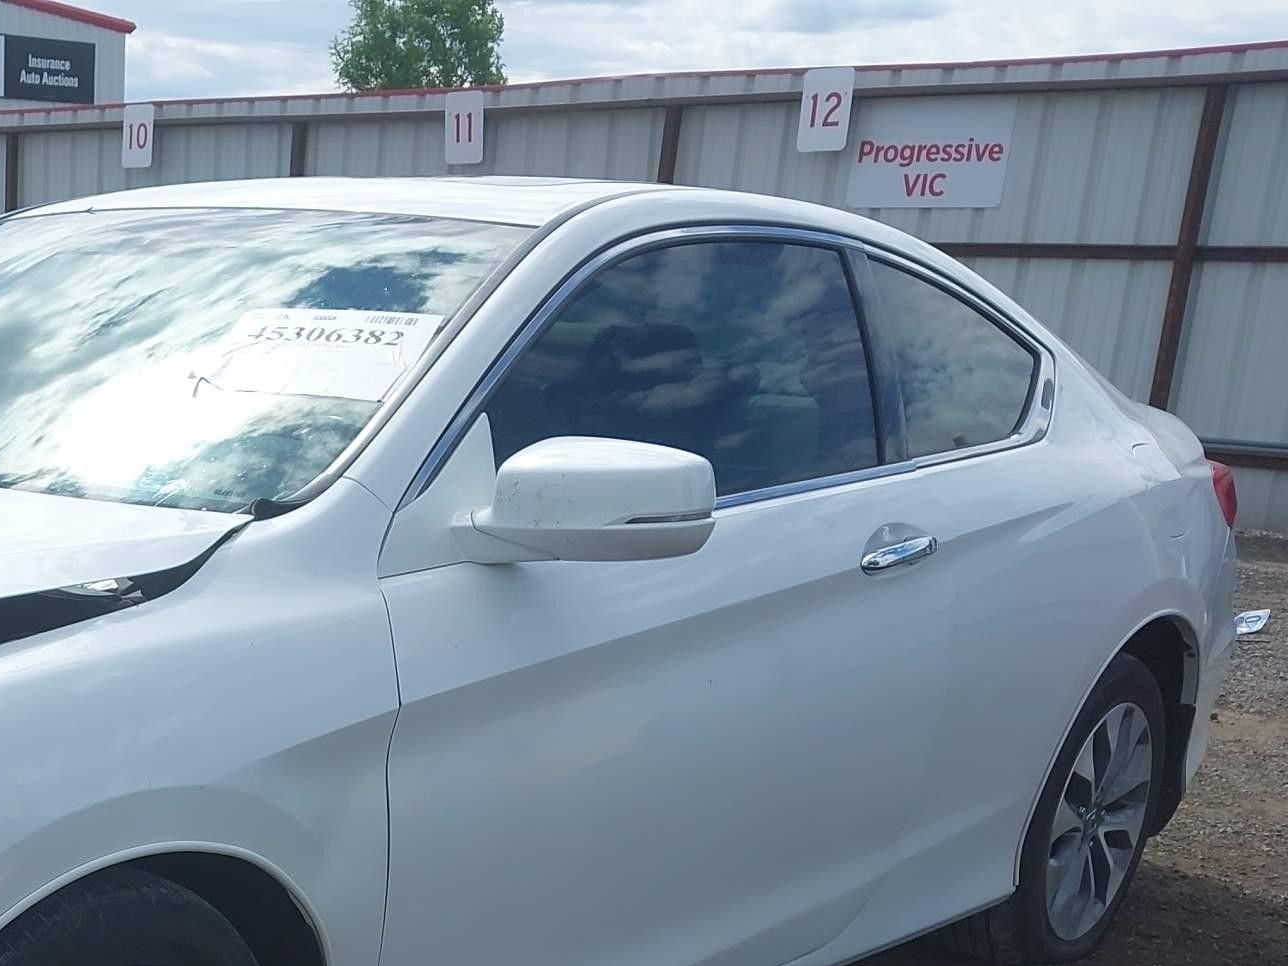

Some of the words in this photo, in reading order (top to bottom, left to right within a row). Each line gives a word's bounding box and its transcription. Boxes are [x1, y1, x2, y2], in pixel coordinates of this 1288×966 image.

[28, 53, 71, 71] Insurance
[19, 69, 41, 85] Auto
[41, 72, 79, 88] Auctions
[809, 91, 843, 128] 12
[128, 122, 148, 150] 10
[455, 112, 473, 143] 11
[857, 137, 1004, 168] Progressive
[903, 172, 948, 198] VIC
[248, 326, 404, 346] 45306382
